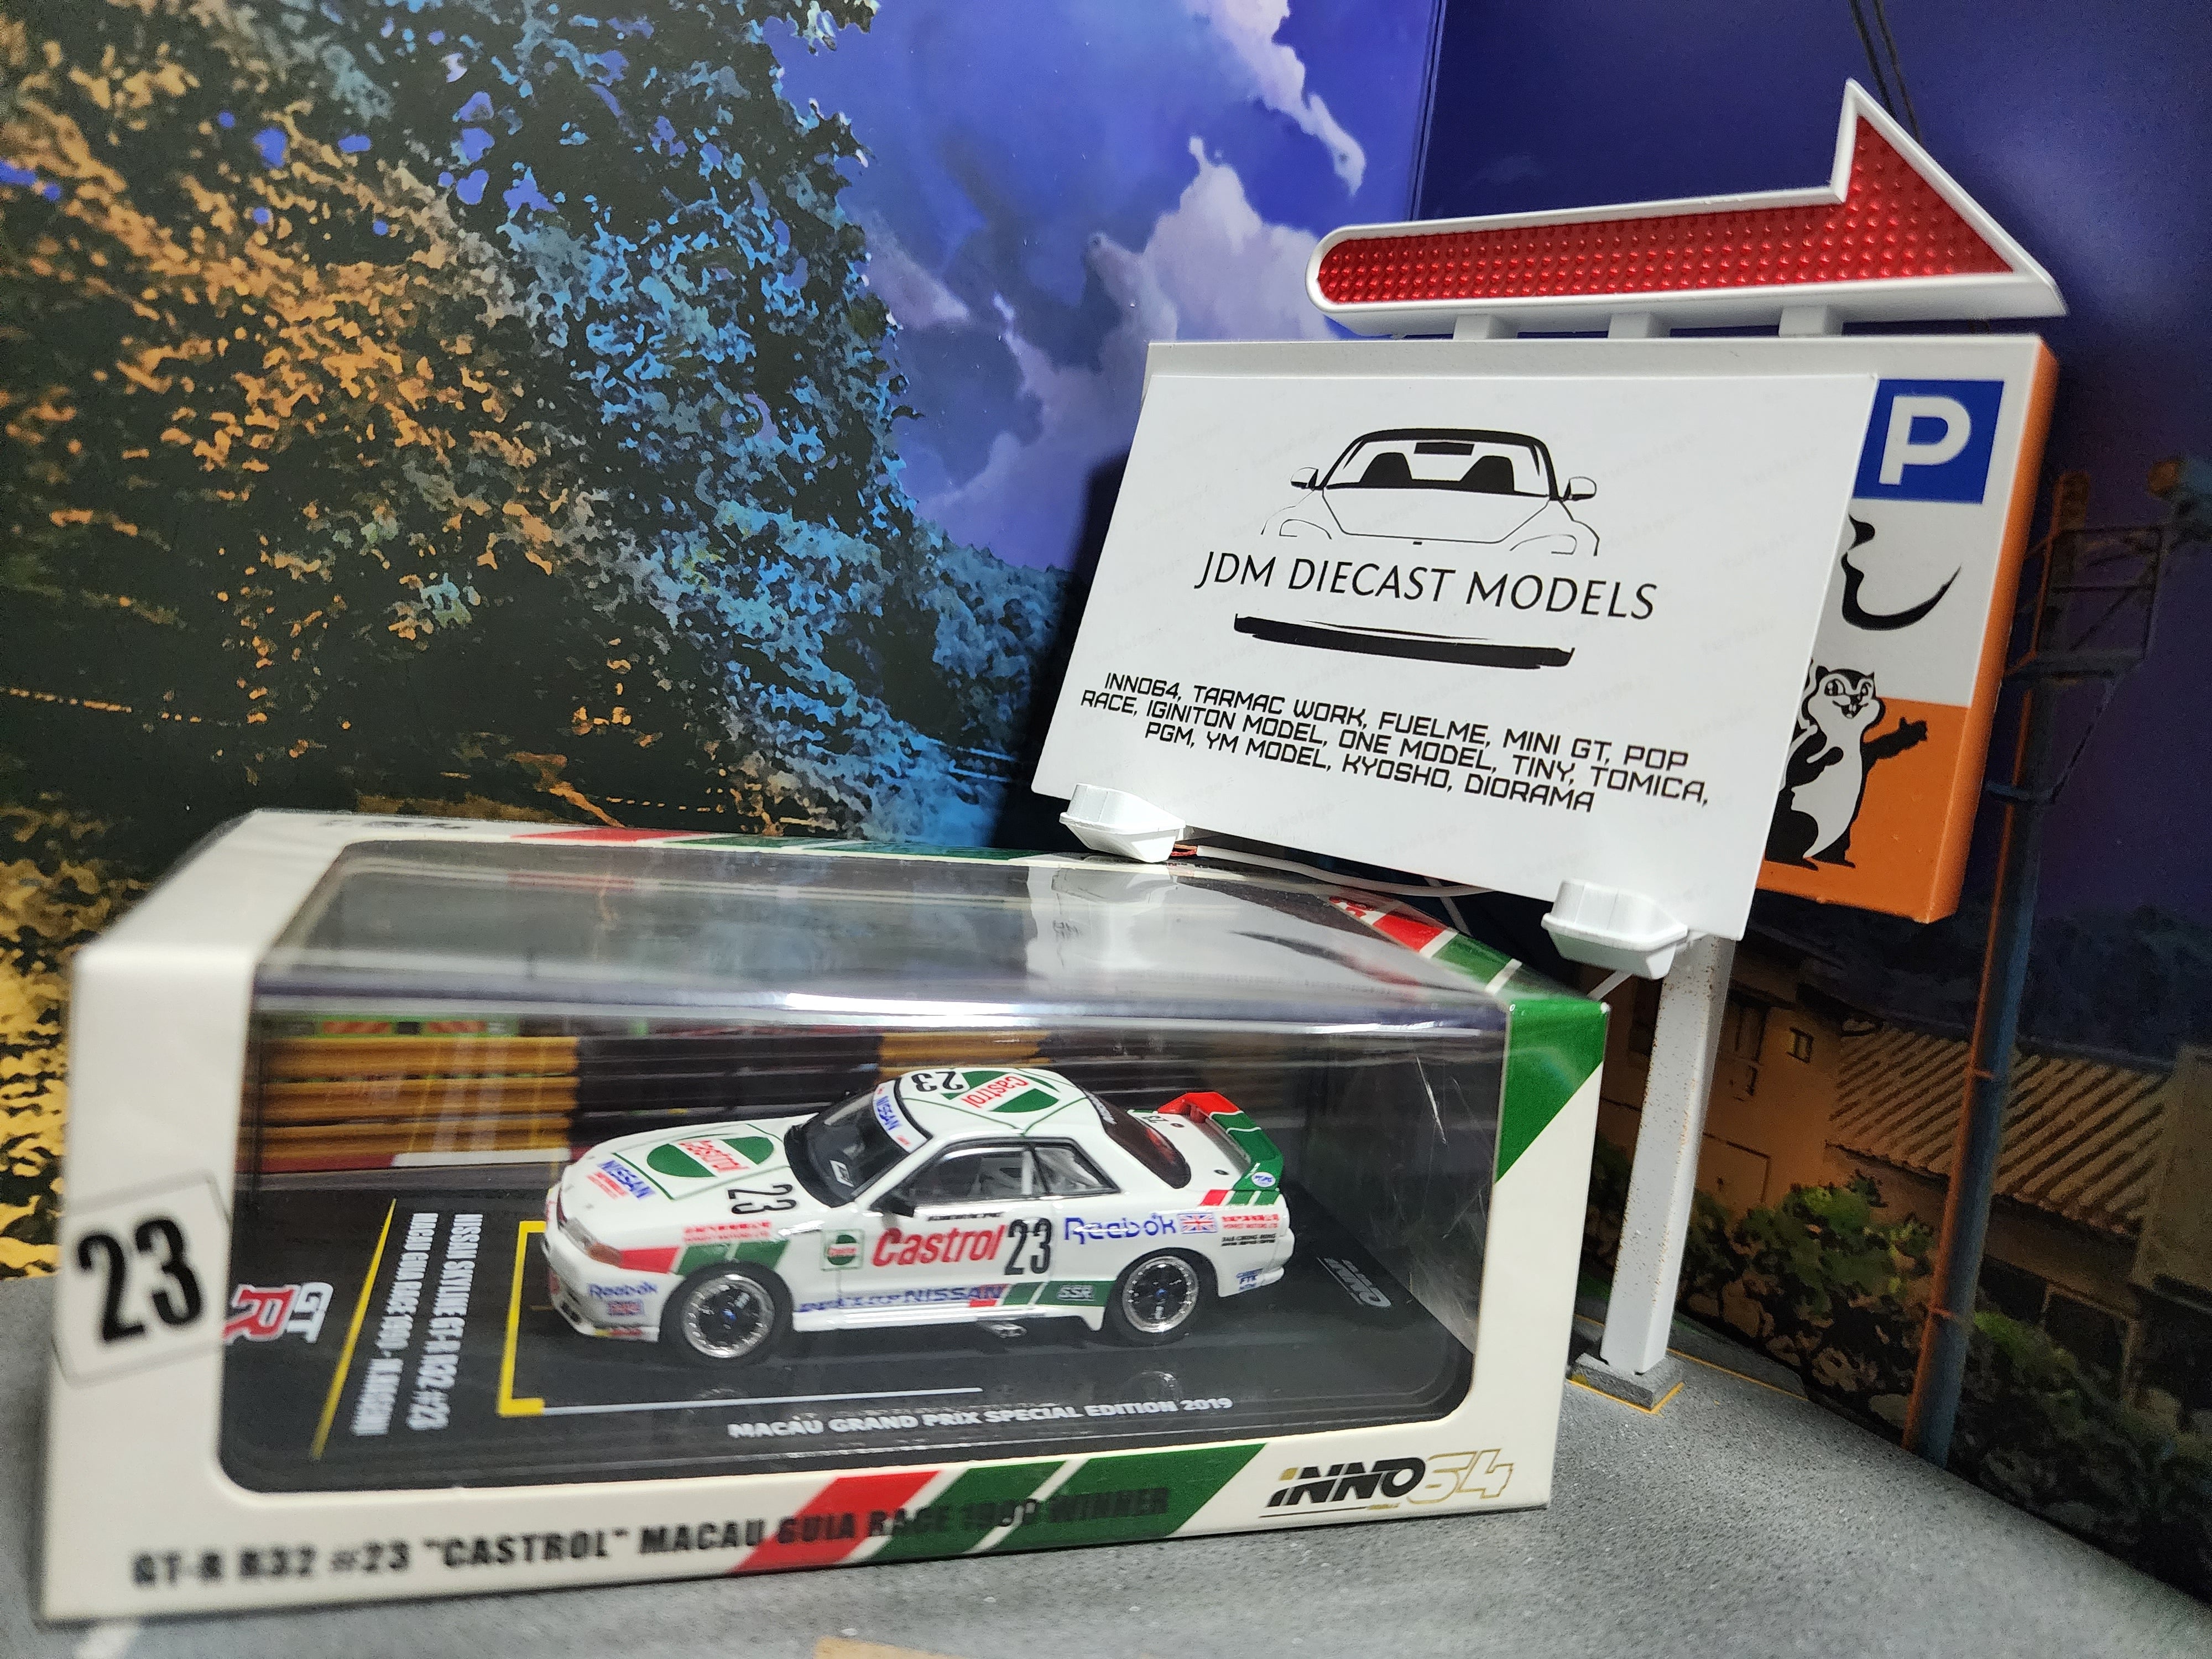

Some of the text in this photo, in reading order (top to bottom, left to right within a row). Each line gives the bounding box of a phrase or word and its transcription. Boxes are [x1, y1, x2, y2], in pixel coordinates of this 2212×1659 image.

[1879, 395, 1971, 486] P
[1193, 551, 1657, 620] JDM DIECAST MODELS
[1081, 690, 1708, 806] RACE, IGINITON MODEL, ONE MODEL, TINY, TOMICA,
[1104, 672, 1689, 771] INNO64, TARMAC WORK, FUELME, MINI GT, POP
[1145, 721, 1595, 812] PGM, YM MODEL, KYOSHO, DIORAMA
[911, 1071, 964, 1092] 23
[961, 1075, 1030, 1109] Castrol
[727, 1183, 797, 1214] 23
[872, 1213, 1177, 1276] Castrol 23 Reebok
[76, 1217, 204, 1344] 23
[905, 1285, 1006, 1303] NISSAN
[828, 1415, 919, 1432] GRAND
[922, 1411, 983, 1427] PRIX
[983, 1406, 1084, 1423] SPECIAL
[1085, 1401, 1179, 1417] EDITION
[1180, 1397, 1233, 1411] 2019
[424, 1527, 628, 1569] "CASTROL"
[639, 1517, 767, 1553] MACAU
[776, 1511, 858, 1544] GUIA
